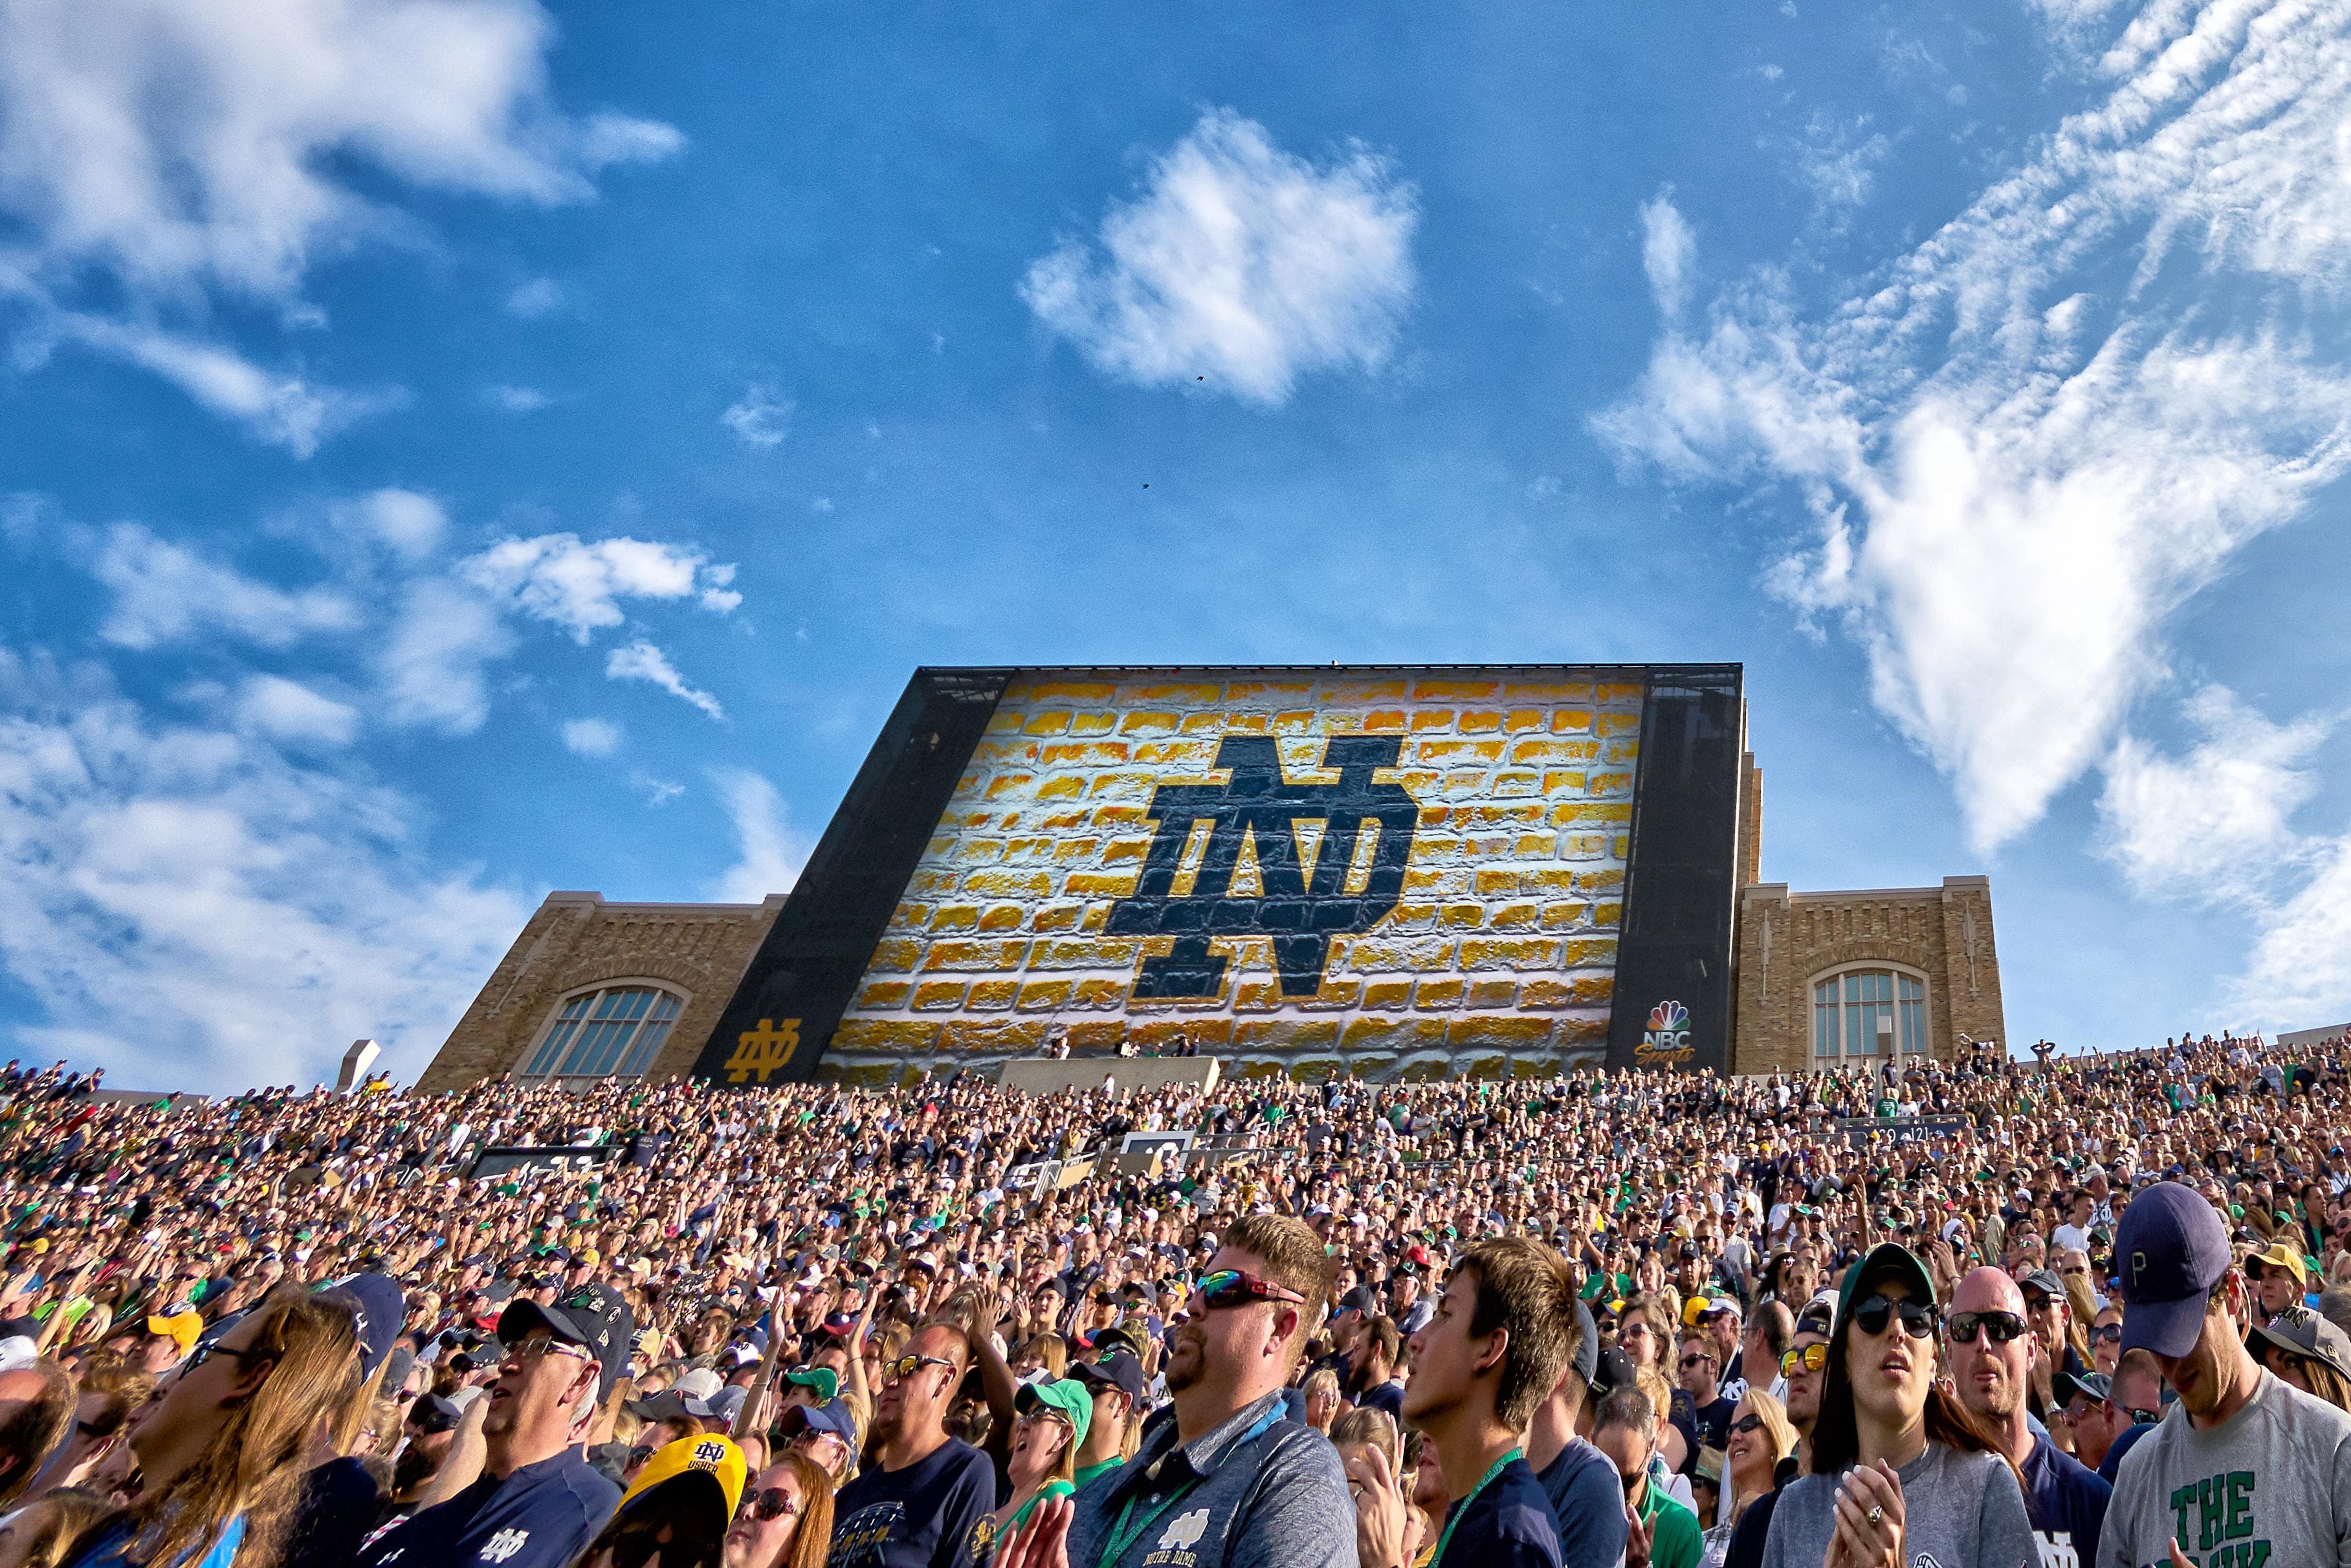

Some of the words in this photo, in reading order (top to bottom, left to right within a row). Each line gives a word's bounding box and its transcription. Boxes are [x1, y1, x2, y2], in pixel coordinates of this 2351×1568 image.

[1643, 1030, 1692, 1050] NBC
[1633, 1043, 1696, 1067] Sports
[1910, 1126, 1928, 1142] 121
[2131, 1251, 2147, 1287] P
[687, 1461, 718, 1476] USHER
[2170, 1470, 2255, 1551] THE
[1142, 1550, 1172, 1567] NOTRE
[1171, 1550, 1197, 1568] DAME
